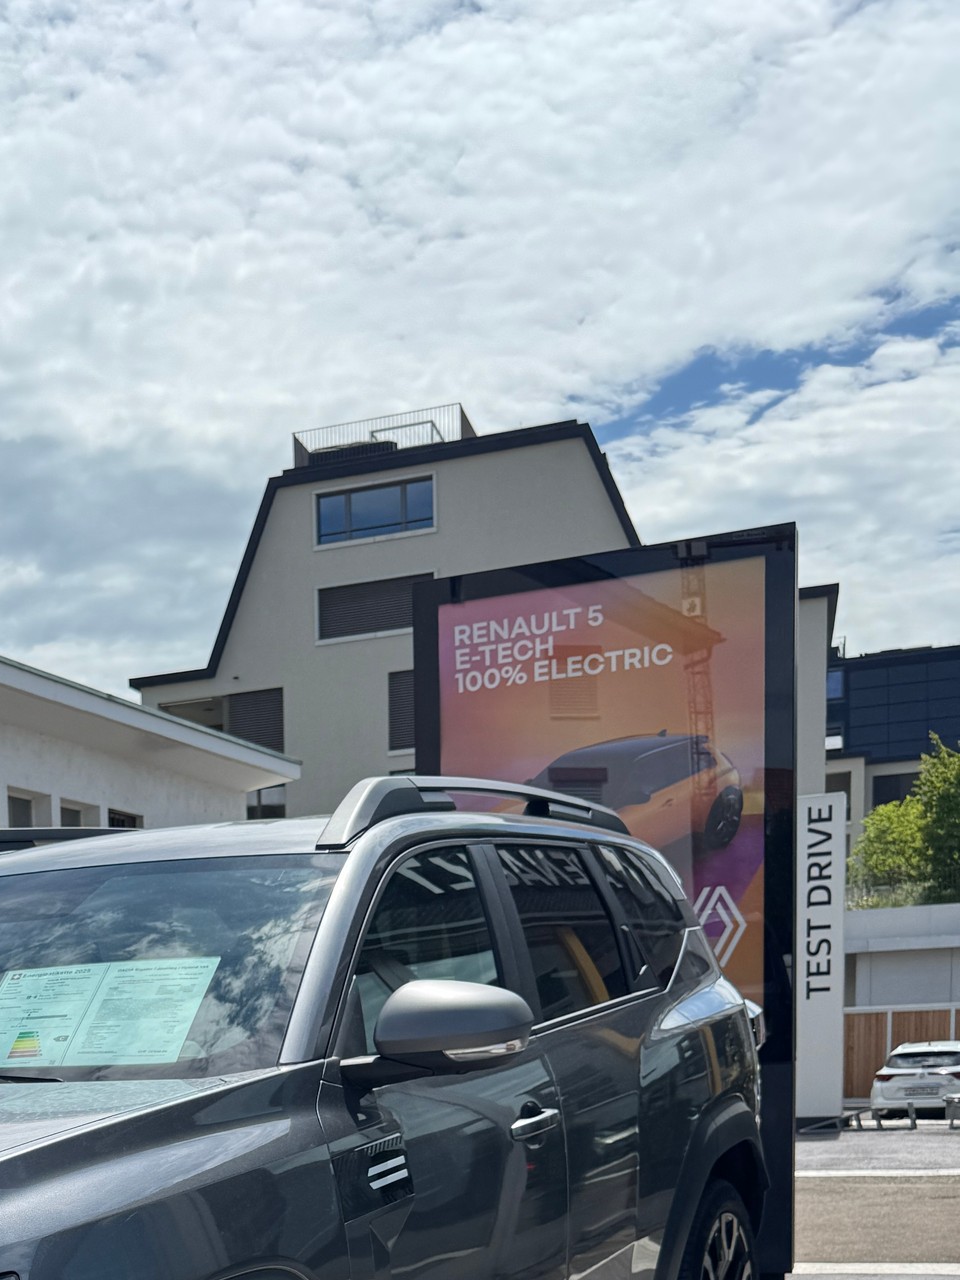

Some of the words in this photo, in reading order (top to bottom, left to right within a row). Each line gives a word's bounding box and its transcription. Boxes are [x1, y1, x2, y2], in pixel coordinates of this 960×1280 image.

[454, 607, 582, 646] RENAULT
[587, 604, 604, 627] 5
[454, 636, 554, 670] E-TECH
[455, 664, 528, 694] 100%
[534, 643, 673, 682] ELECTRIC
[807, 804, 833, 909] DRIVE
[806, 918, 832, 1000] TEST
